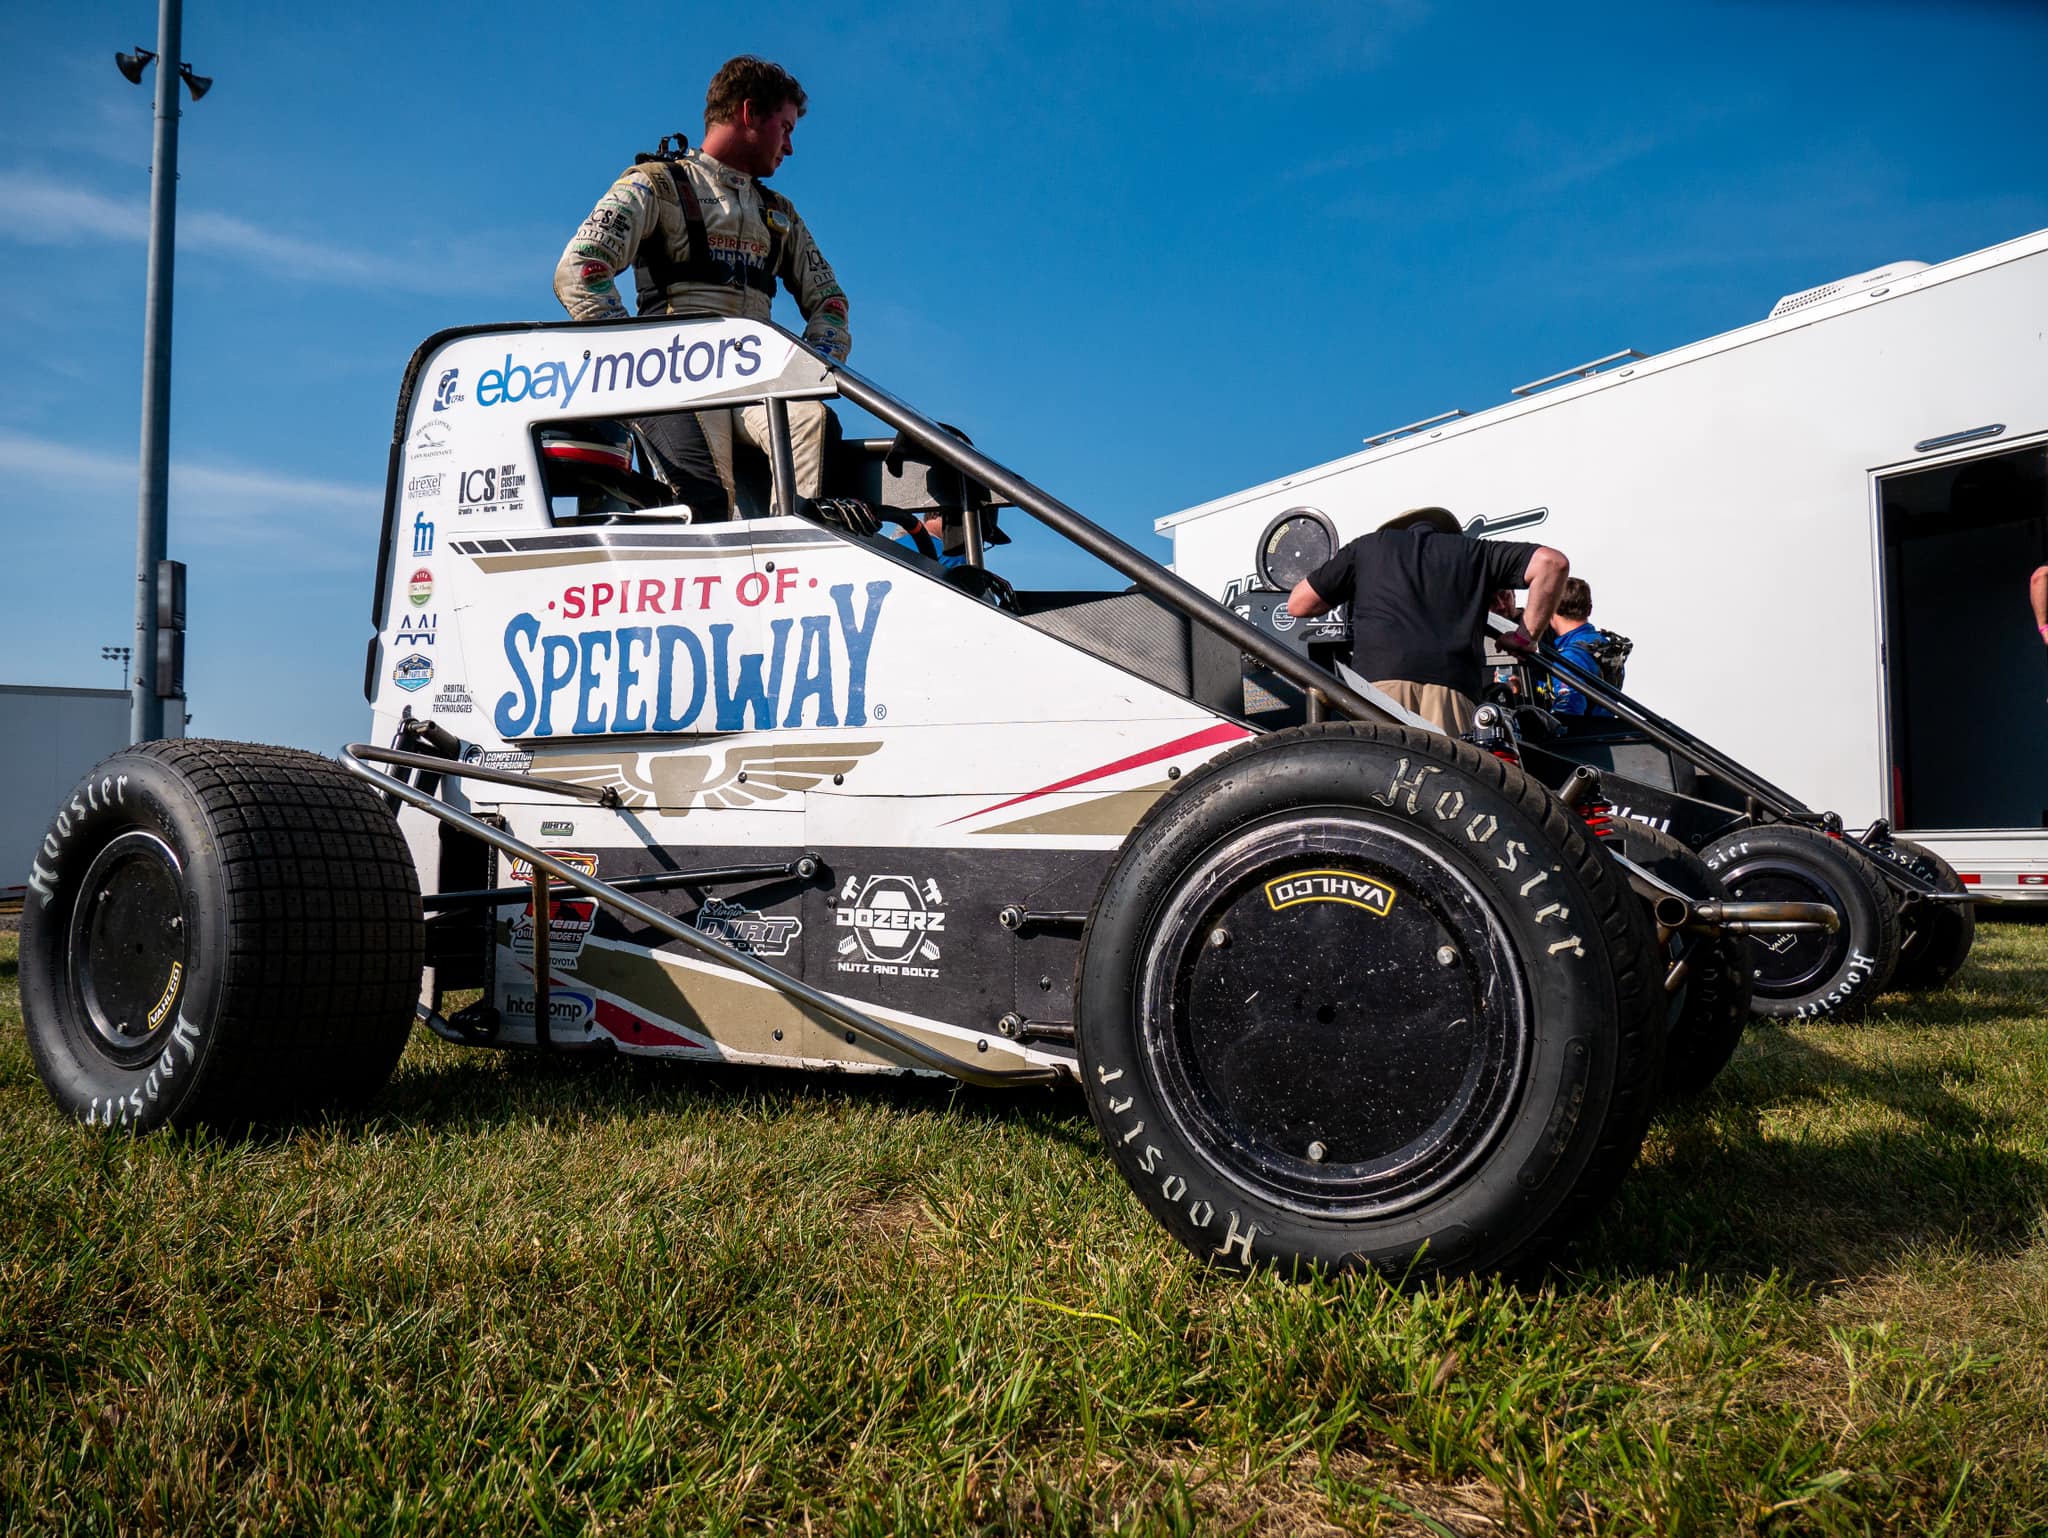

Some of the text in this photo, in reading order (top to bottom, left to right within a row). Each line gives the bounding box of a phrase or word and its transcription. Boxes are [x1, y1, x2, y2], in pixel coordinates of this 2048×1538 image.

[708, 236, 750, 250] SPIRIT
[408, 473, 441, 491] drexel
[500, 474, 525, 488] CUSTOM
[501, 463, 516, 476] INDY
[408, 488, 441, 499] INTERIORS
[459, 468, 496, 504] ICS
[500, 487, 520, 500] STONE
[562, 568, 800, 620] SPIRIT OF
[493, 579, 893, 738] SPEEDWAY
[434, 694, 473, 703] INSTALLATION
[443, 684, 466, 693] ORBITAL
[433, 704, 473, 713] TECHNOLOGIES
[485, 751, 533, 762] COMPETITION
[28, 773, 129, 911] Hoosier
[1370, 758, 1586, 959] Hoosier
[1273, 878, 1387, 908] VAHLCO
[700, 916, 796, 943] DIRT
[836, 907, 946, 932] DOZERZ
[838, 962, 940, 978] NUTZ AND BOLTZ
[1796, 947, 1875, 1018] Hoosier
[150, 966, 181, 1025] VAHLCO
[506, 994, 583, 1022] Inteomp
[1098, 1064, 1273, 1265] Hoosier
